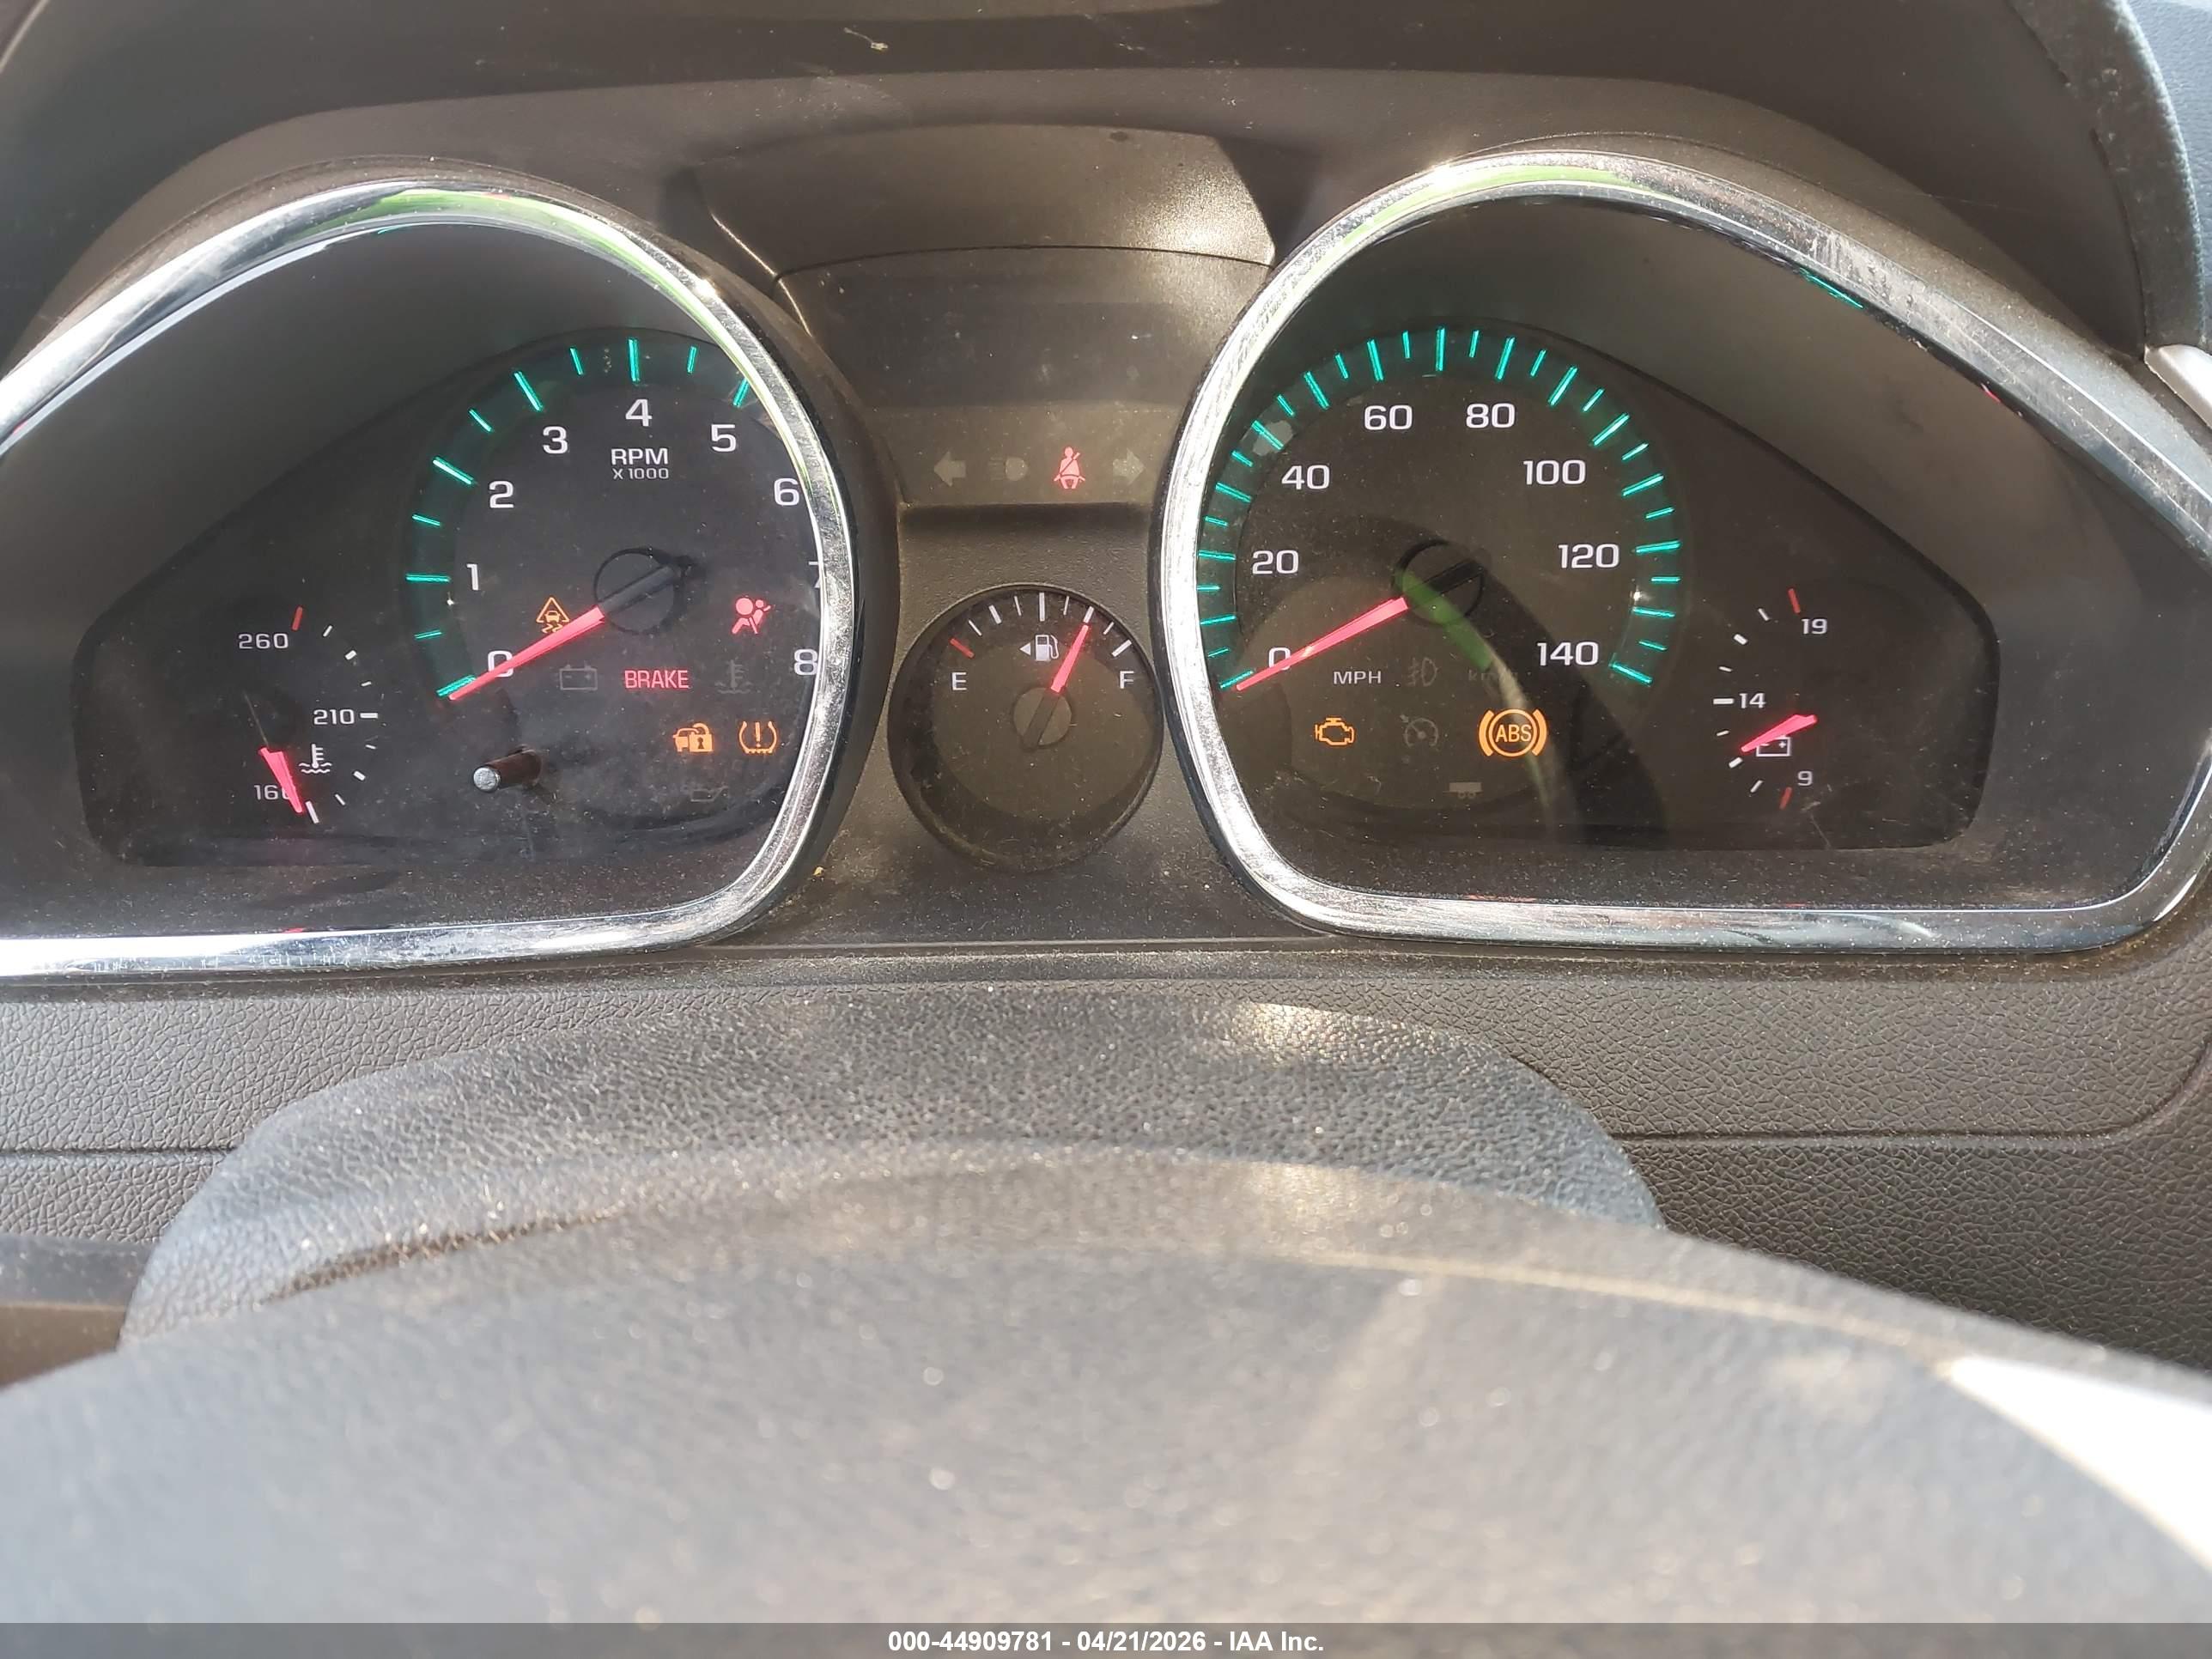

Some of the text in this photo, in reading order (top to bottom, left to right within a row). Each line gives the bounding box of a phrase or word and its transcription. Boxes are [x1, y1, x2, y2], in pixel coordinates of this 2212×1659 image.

[625, 398, 653, 427] 4
[1364, 404, 1413, 431] 60
[1466, 403, 1516, 428] 80
[543, 426, 568, 454] 3
[711, 423, 737, 453] 5
[611, 447, 669, 465] RPM
[1281, 465, 1330, 490] 40
[1522, 459, 1586, 485] 100
[489, 480, 514, 508] 2
[774, 477, 799, 507] 6
[1252, 550, 1299, 574] 20
[1558, 544, 1620, 568] 120
[466, 563, 479, 591] 1
[1802, 618, 1827, 635] 19
[238, 632, 289, 649] 260
[794, 648, 817, 676] 8
[1537, 641, 1599, 666] 140
[624, 669, 690, 689] BRAKE
[951, 672, 967, 691] E
[1119, 670, 1134, 689] F
[1333, 671, 1382, 684] MPH
[1739, 692, 1766, 709] 14
[313, 708, 355, 725] 210
[1495, 724, 1532, 743] ABS
[1797, 770, 1813, 787] 9
